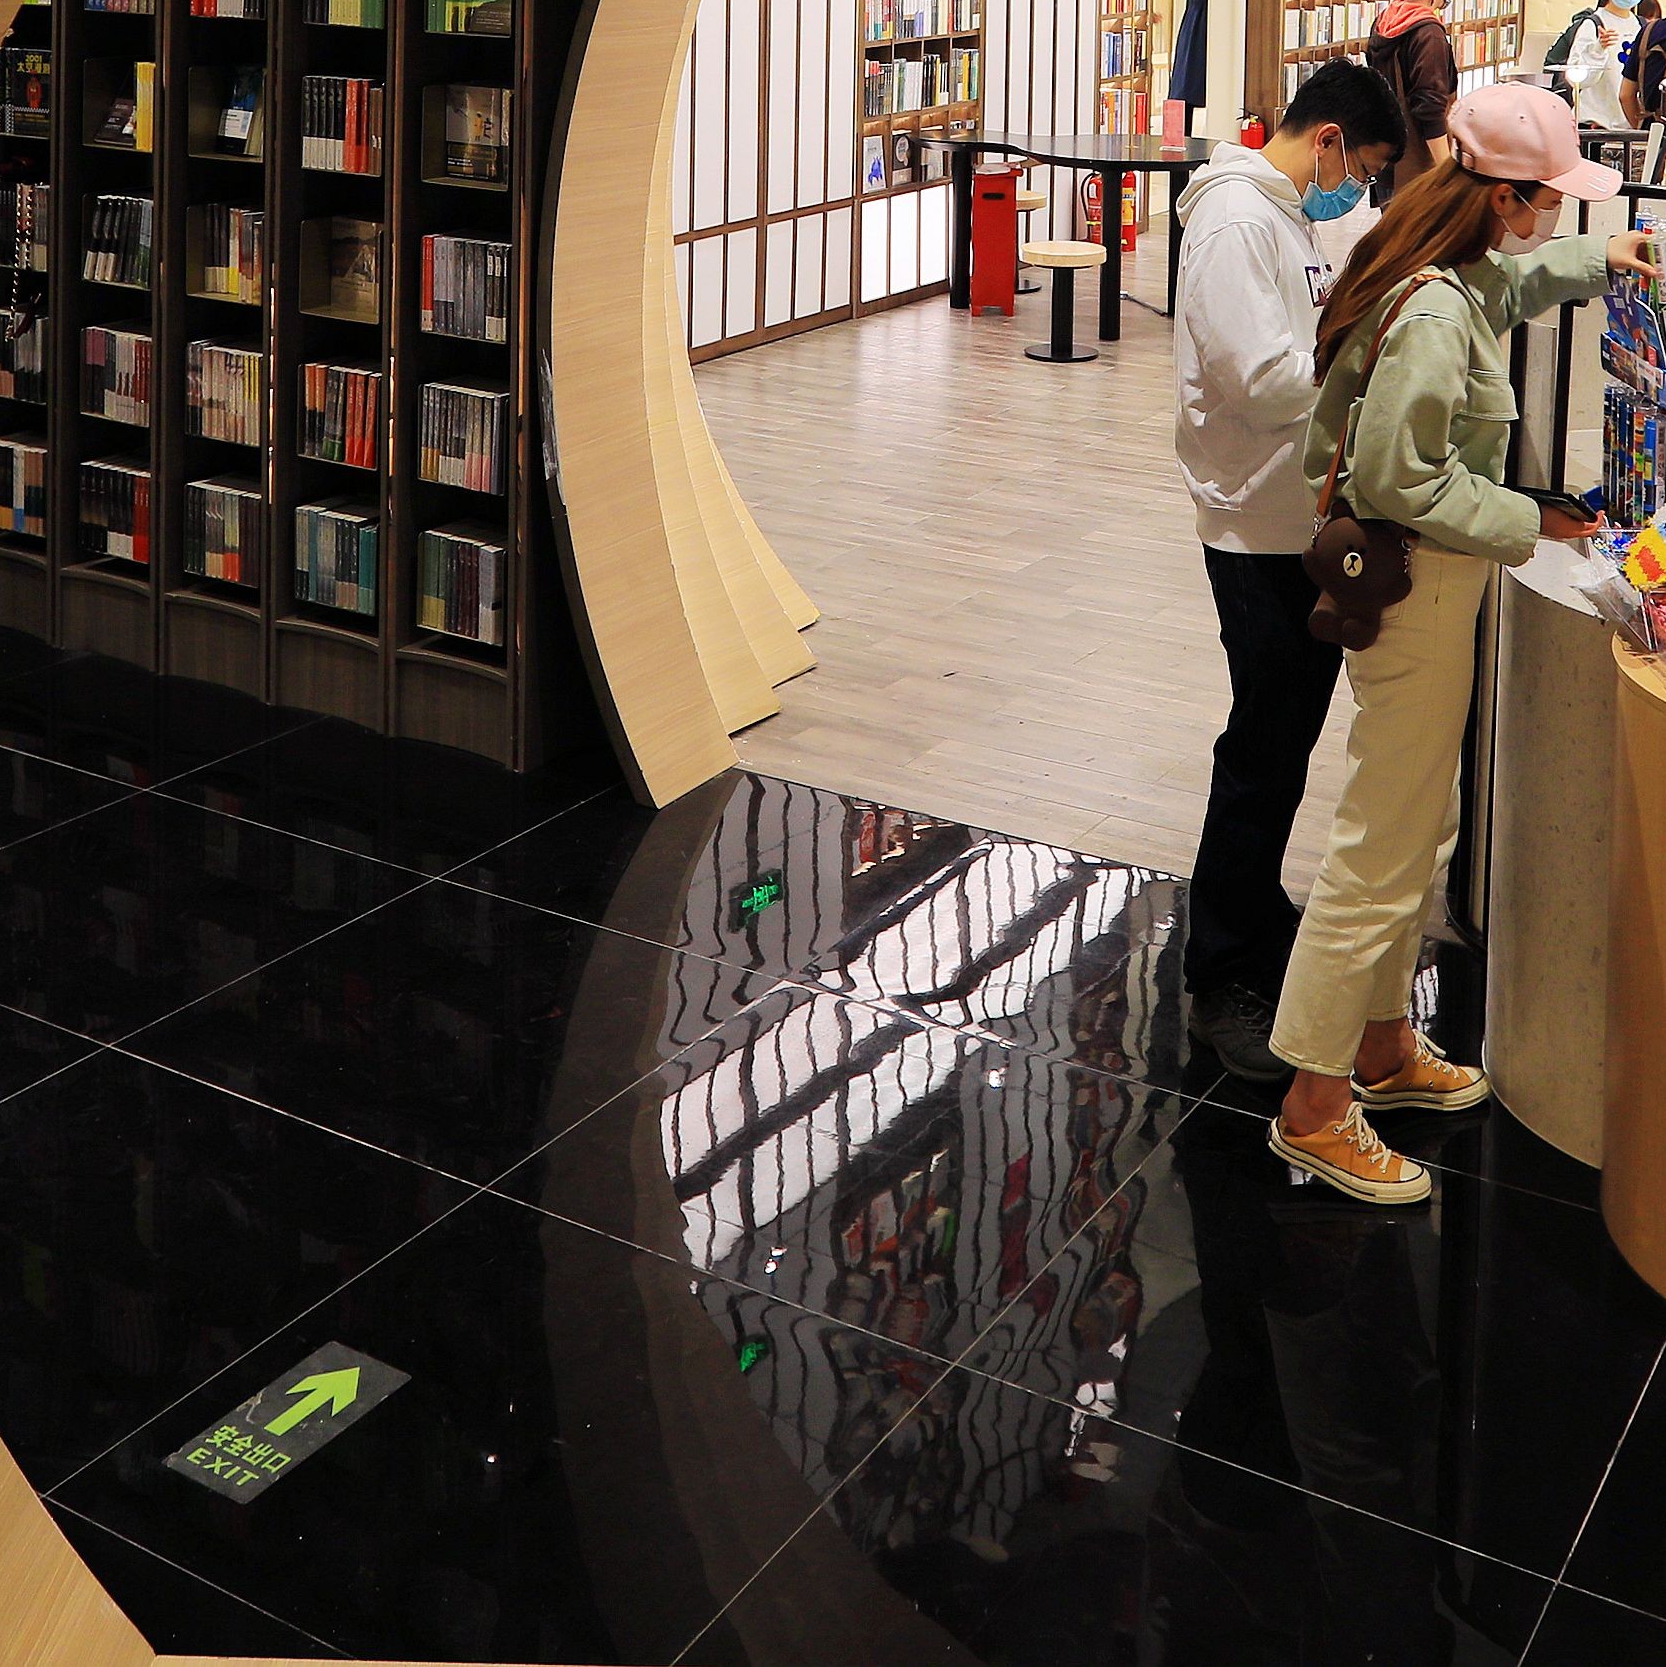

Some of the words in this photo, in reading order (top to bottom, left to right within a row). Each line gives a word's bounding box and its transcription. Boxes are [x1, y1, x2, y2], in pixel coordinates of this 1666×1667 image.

[186, 1446, 260, 1487] EXIT
[204, 1424, 292, 1474] 安全出口
